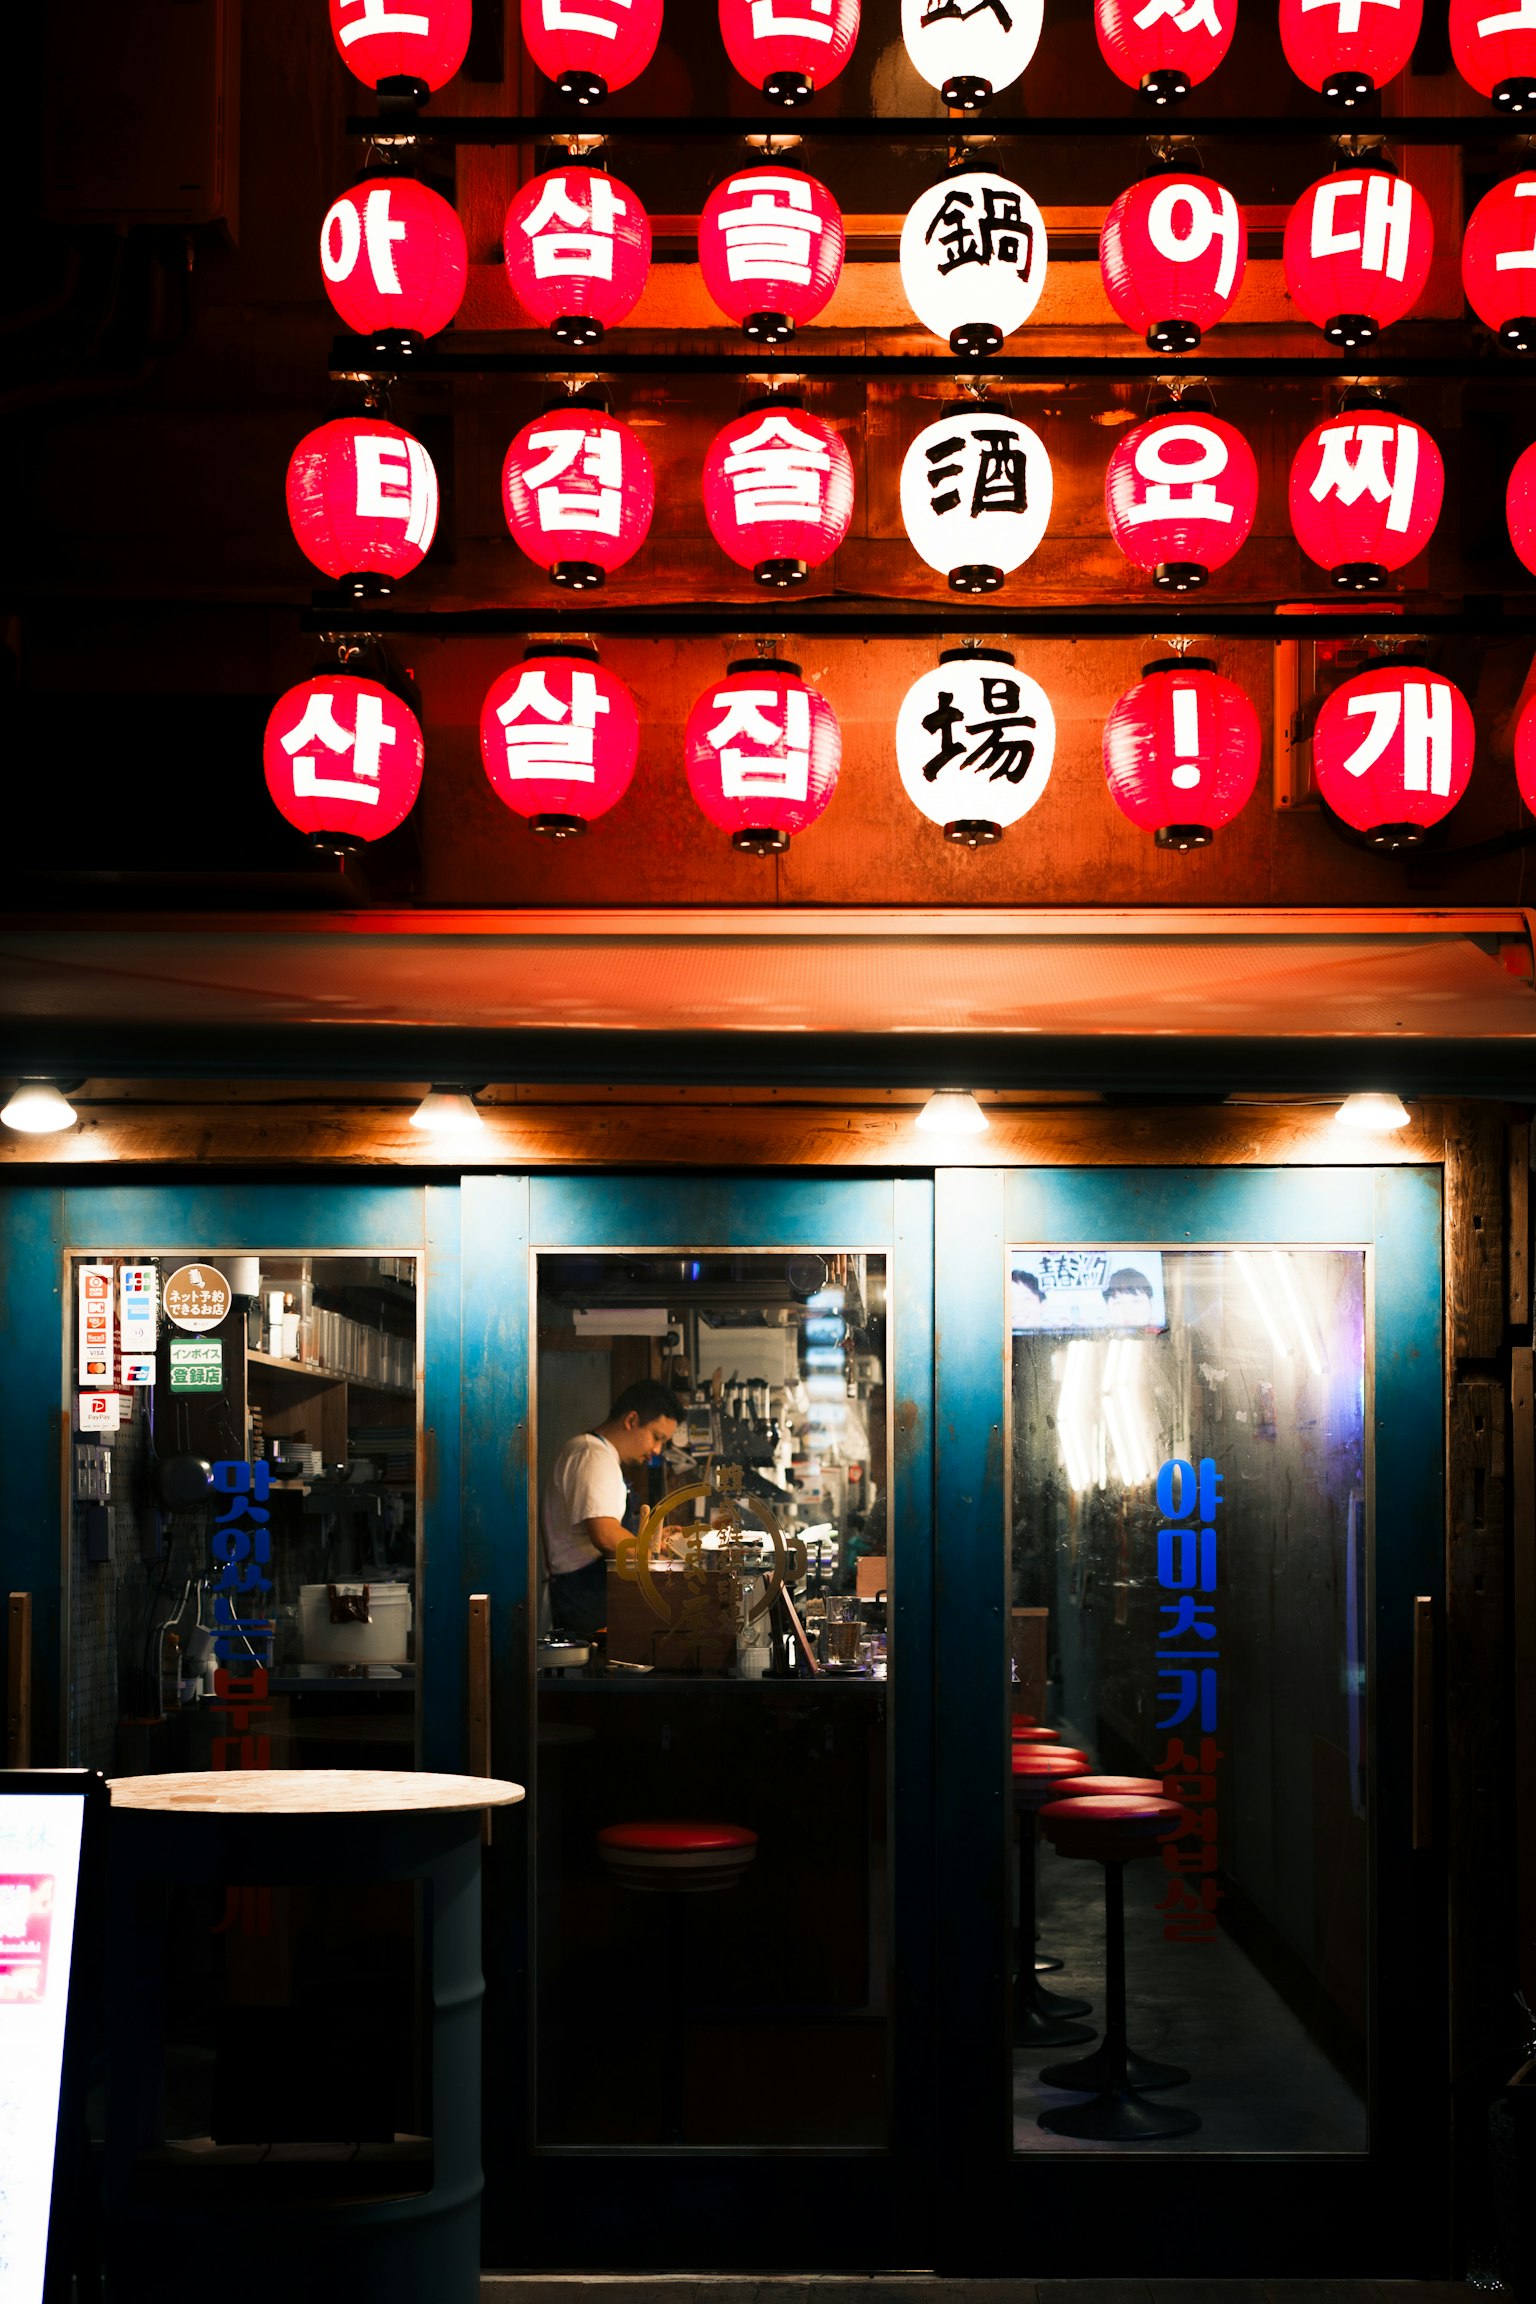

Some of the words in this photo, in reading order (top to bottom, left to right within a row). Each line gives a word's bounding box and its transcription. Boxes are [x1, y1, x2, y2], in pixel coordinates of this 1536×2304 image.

[169, 1290, 225, 1302] ネット予約
[169, 1304, 225, 1316] できるお店
[172, 1348, 221, 1359] インボイス
[172, 1367, 221, 1384] 登録店
[209, 1460, 277, 1661] 맛있는
[1154, 1457, 1225, 1733] 야미츠키
[1153, 1736, 1225, 1943] 삼겹살
